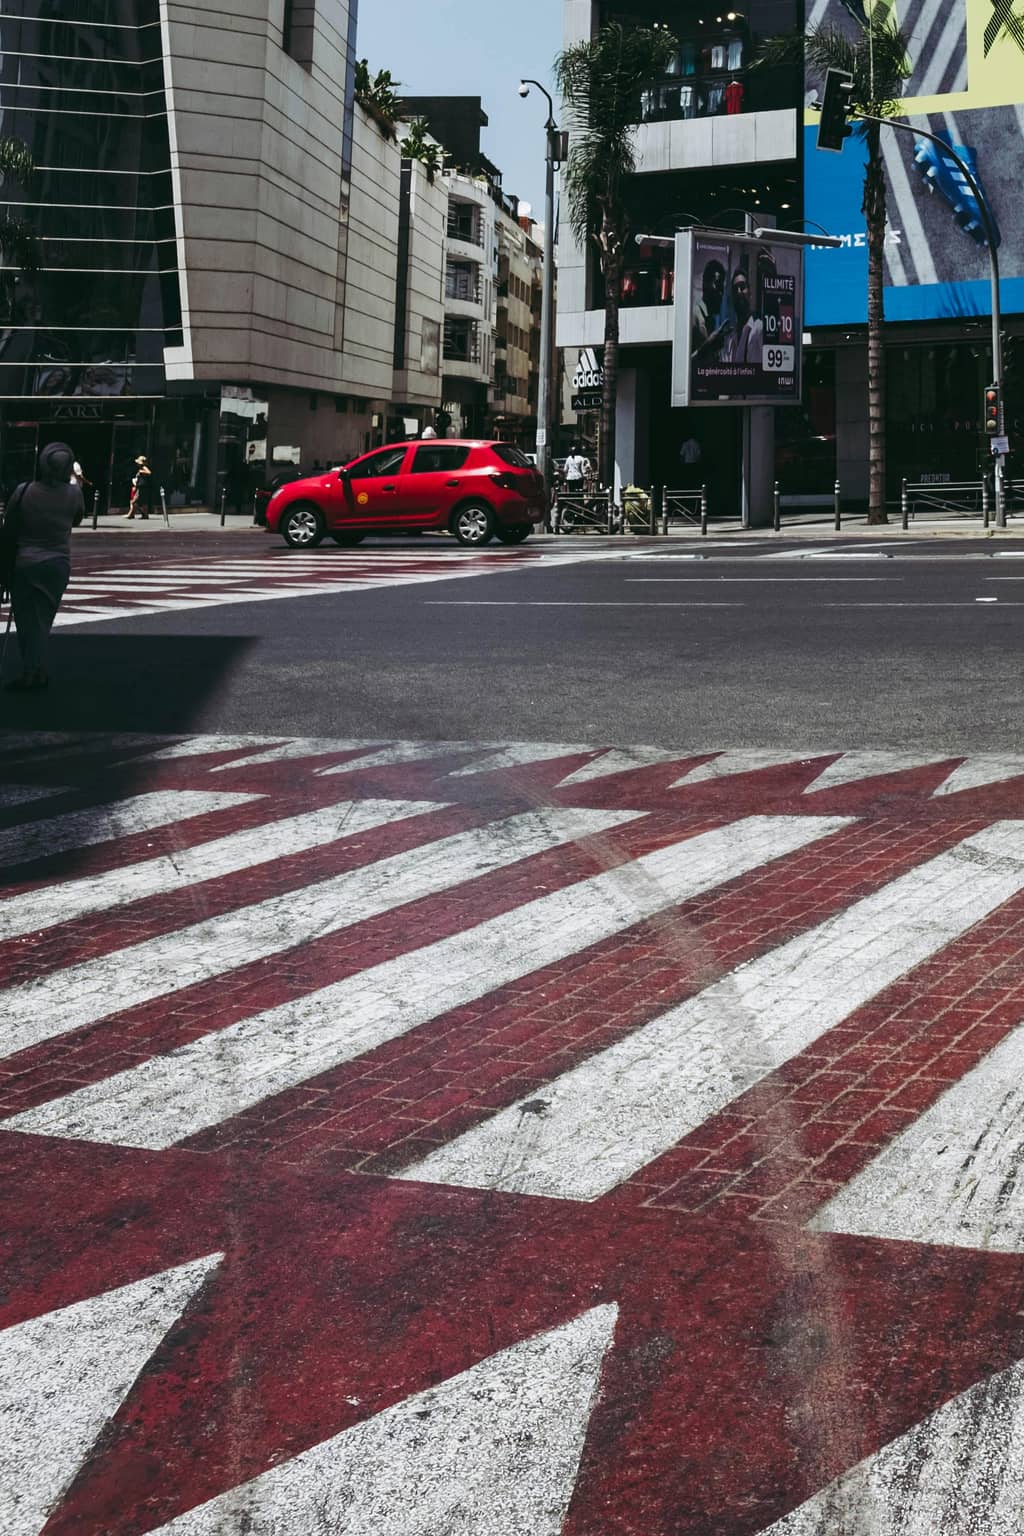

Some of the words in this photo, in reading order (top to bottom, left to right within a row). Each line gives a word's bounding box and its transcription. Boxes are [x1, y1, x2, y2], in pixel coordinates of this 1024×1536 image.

[764, 276, 794, 290] ILLIMITÉ
[764, 315, 777, 332] 10
[781, 315, 793, 333] 10
[767, 349, 783, 368] 99
[574, 397, 602, 406] ALD
[54, 405, 101, 417] ZARA
